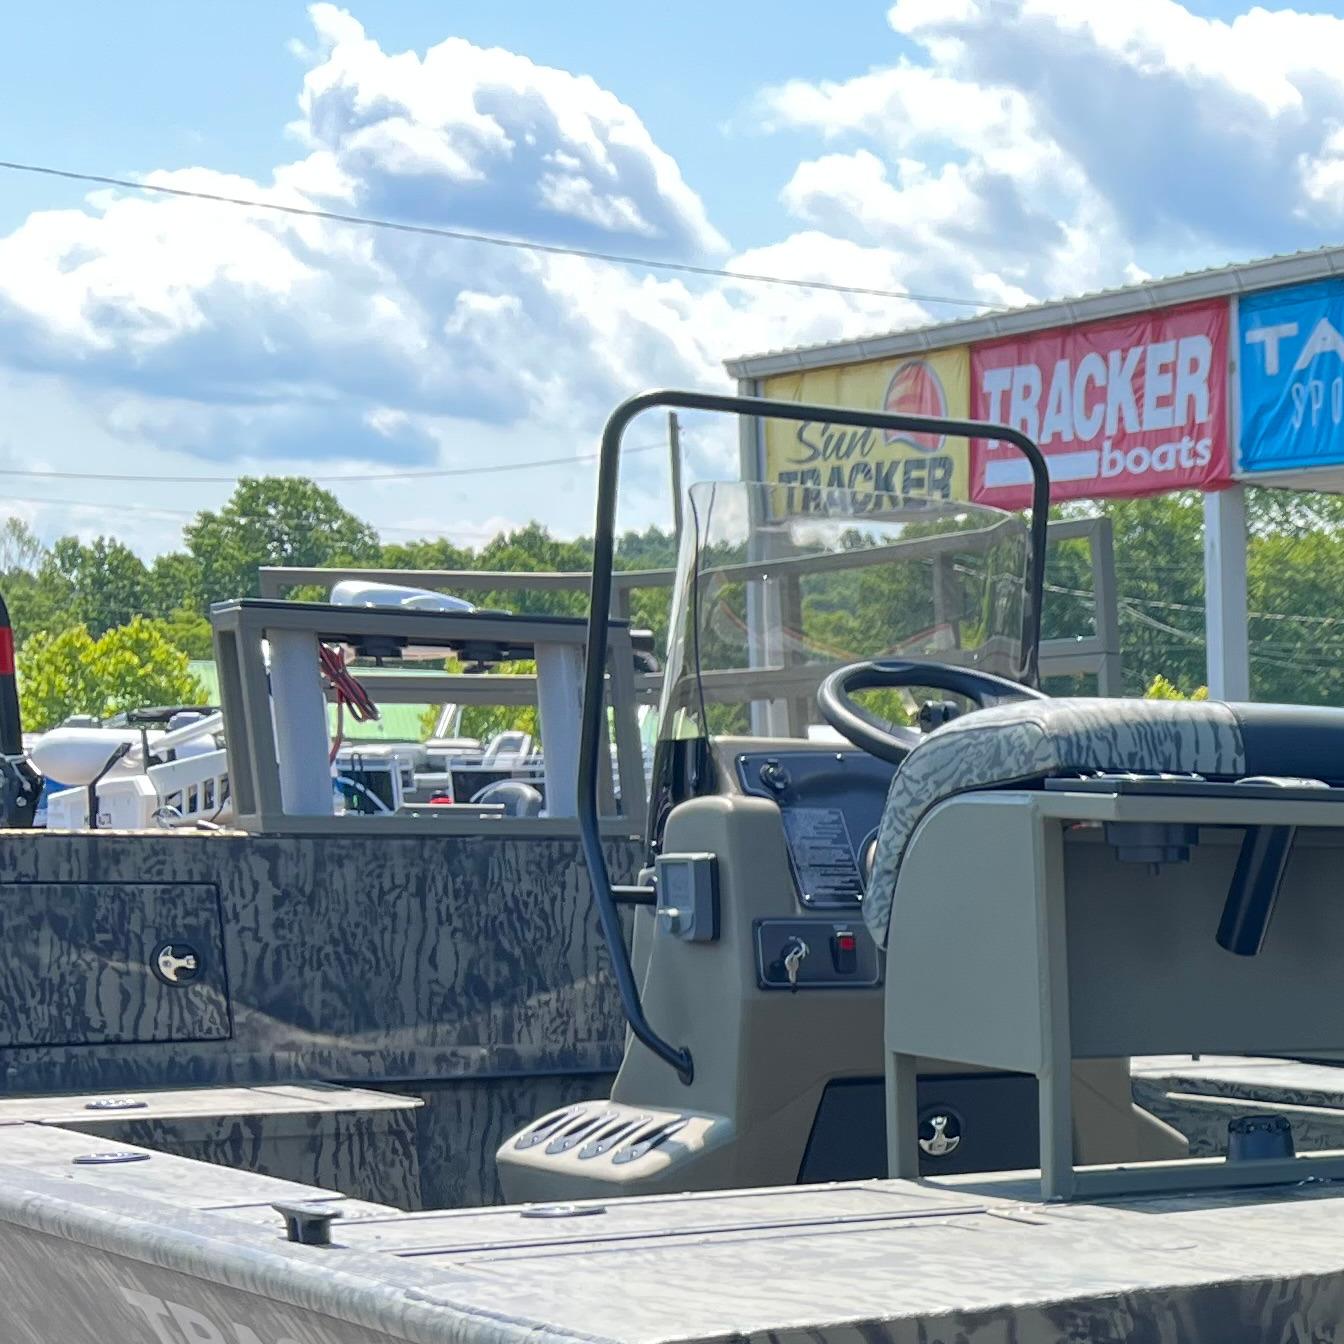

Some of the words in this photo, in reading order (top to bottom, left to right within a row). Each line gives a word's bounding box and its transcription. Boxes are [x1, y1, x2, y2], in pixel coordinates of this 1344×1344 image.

[981, 334, 1214, 450] TRACKER
[787, 420, 877, 465] Sun
[1101, 434, 1214, 479] boats
[778, 456, 955, 515] TRACKER
